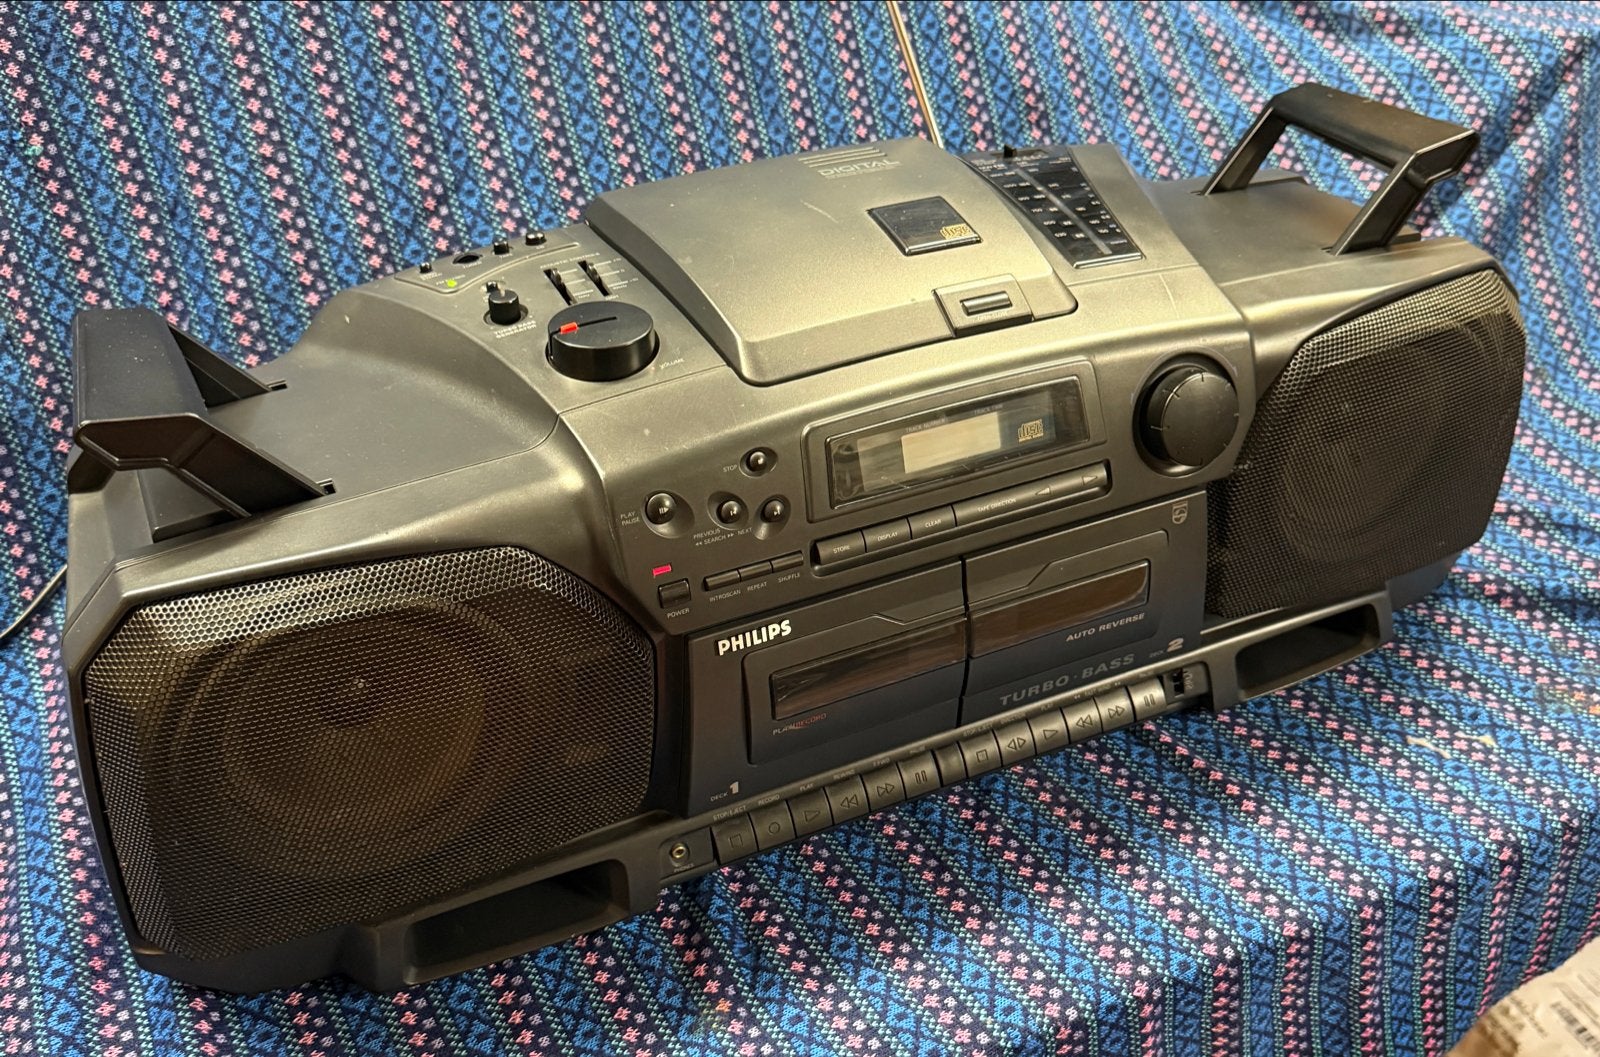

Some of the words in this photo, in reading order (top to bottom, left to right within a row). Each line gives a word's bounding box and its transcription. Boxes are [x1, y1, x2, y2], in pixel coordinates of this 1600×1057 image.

[818, 159, 900, 176] DIGITAL
[495, 324, 537, 339] GENERATOR
[659, 357, 684, 369] VOLUME
[723, 464, 738, 473] STOP
[977, 505, 991, 513] TAPE
[990, 497, 1017, 509] DIRECTION
[620, 511, 636, 520] PLAY
[621, 517, 640, 526] PAUSE
[924, 519, 942, 528] CLEAR
[693, 528, 721, 540] PREVIOUS
[703, 535, 727, 546] SEARCH
[737, 527, 753, 536] NEXT
[877, 531, 898, 541] DISPLAY
[833, 545, 851, 554] STORE
[778, 572, 801, 584] SHUFFLE
[747, 581, 768, 592] REPEAT
[709, 589, 741, 603] INTROSCAN
[667, 608, 690, 619] POWER
[1065, 627, 1096, 642] AUTO
[1098, 612, 1146, 632] REVERSE
[717, 620, 792, 656] PHILIPS
[1167, 637, 1184, 653] 2
[1001, 675, 1070, 706] TURBO
[1082, 653, 1136, 679] BASS
[710, 791, 728, 802] DECK
[729, 781, 740, 795] 1
[800, 782, 815, 792] PLAY
[758, 794, 780, 806] RECORD
[712, 805, 747, 821] STOP/EJECT
